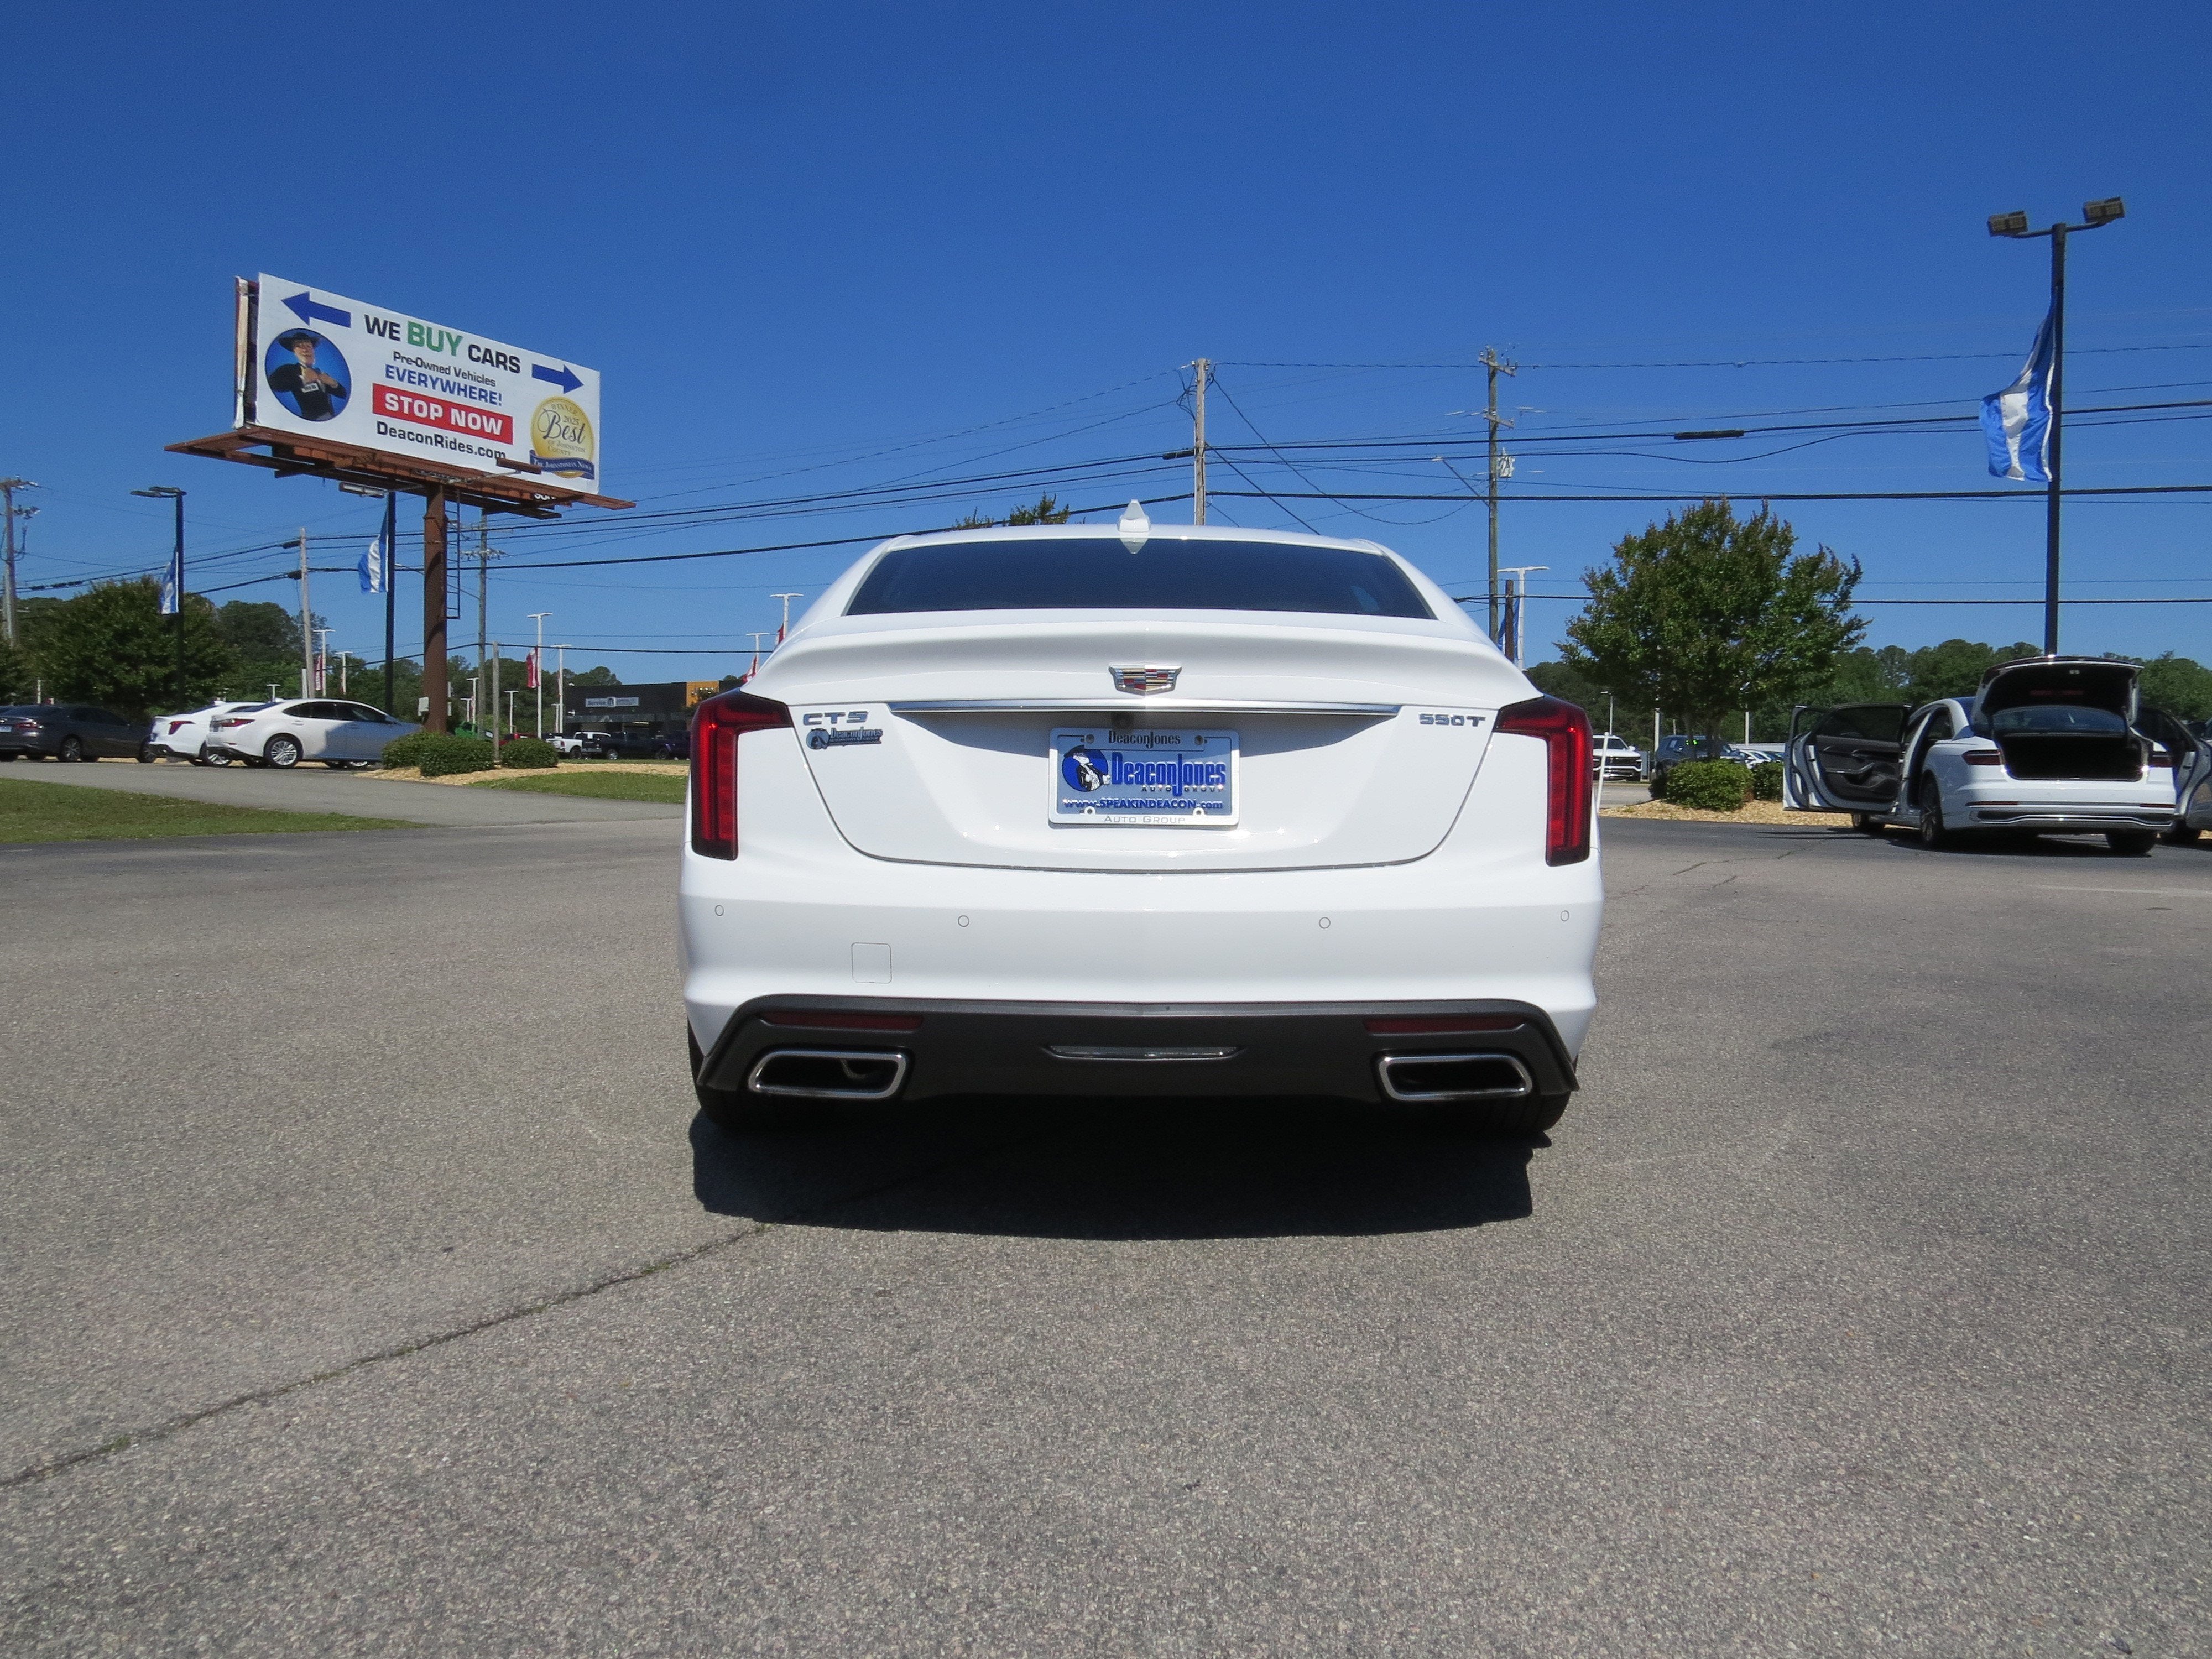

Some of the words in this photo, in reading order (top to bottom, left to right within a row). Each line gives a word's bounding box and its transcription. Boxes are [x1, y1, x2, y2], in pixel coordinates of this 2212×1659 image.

[364, 315, 401, 341] WE
[408, 321, 463, 357] BUY
[468, 344, 521, 374] CARS
[385, 364, 503, 406] EVERYWHERE!
[393, 351, 451, 375] Pre-Owned
[453, 366, 496, 387] Vehicles
[385, 393, 443, 421] STOP
[450, 408, 503, 436] NOW
[538, 408, 586, 444] Best
[377, 420, 506, 460] DeaconRides.com
[1420, 713, 1486, 727] 550T
[1104, 815, 1136, 823] AUTO
[1142, 816, 1185, 824] GROUP
